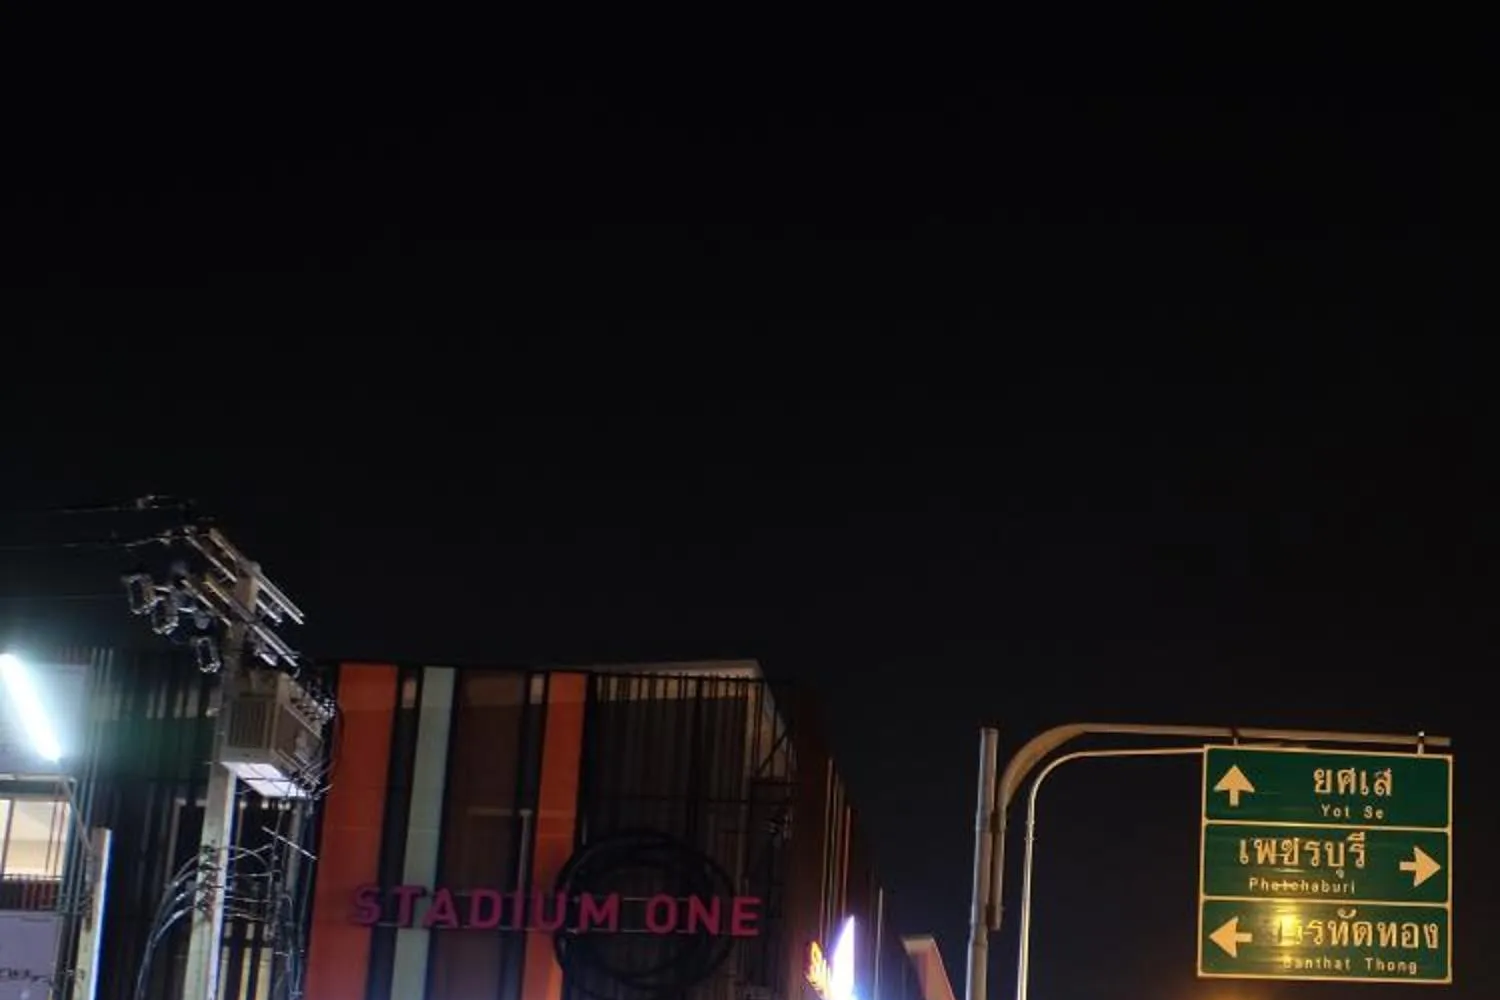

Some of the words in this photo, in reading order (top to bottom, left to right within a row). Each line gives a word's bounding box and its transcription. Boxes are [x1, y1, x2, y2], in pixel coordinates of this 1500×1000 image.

[1313, 767, 1393, 797] ยศเส
[1321, 803, 1351, 818] Yot
[1363, 805, 1384, 819] Se
[1239, 831, 1367, 879] เพชรบุรี
[353, 884, 620, 933] STADIUM
[645, 894, 762, 936] ONE
[1364, 956, 1418, 975] Thong
